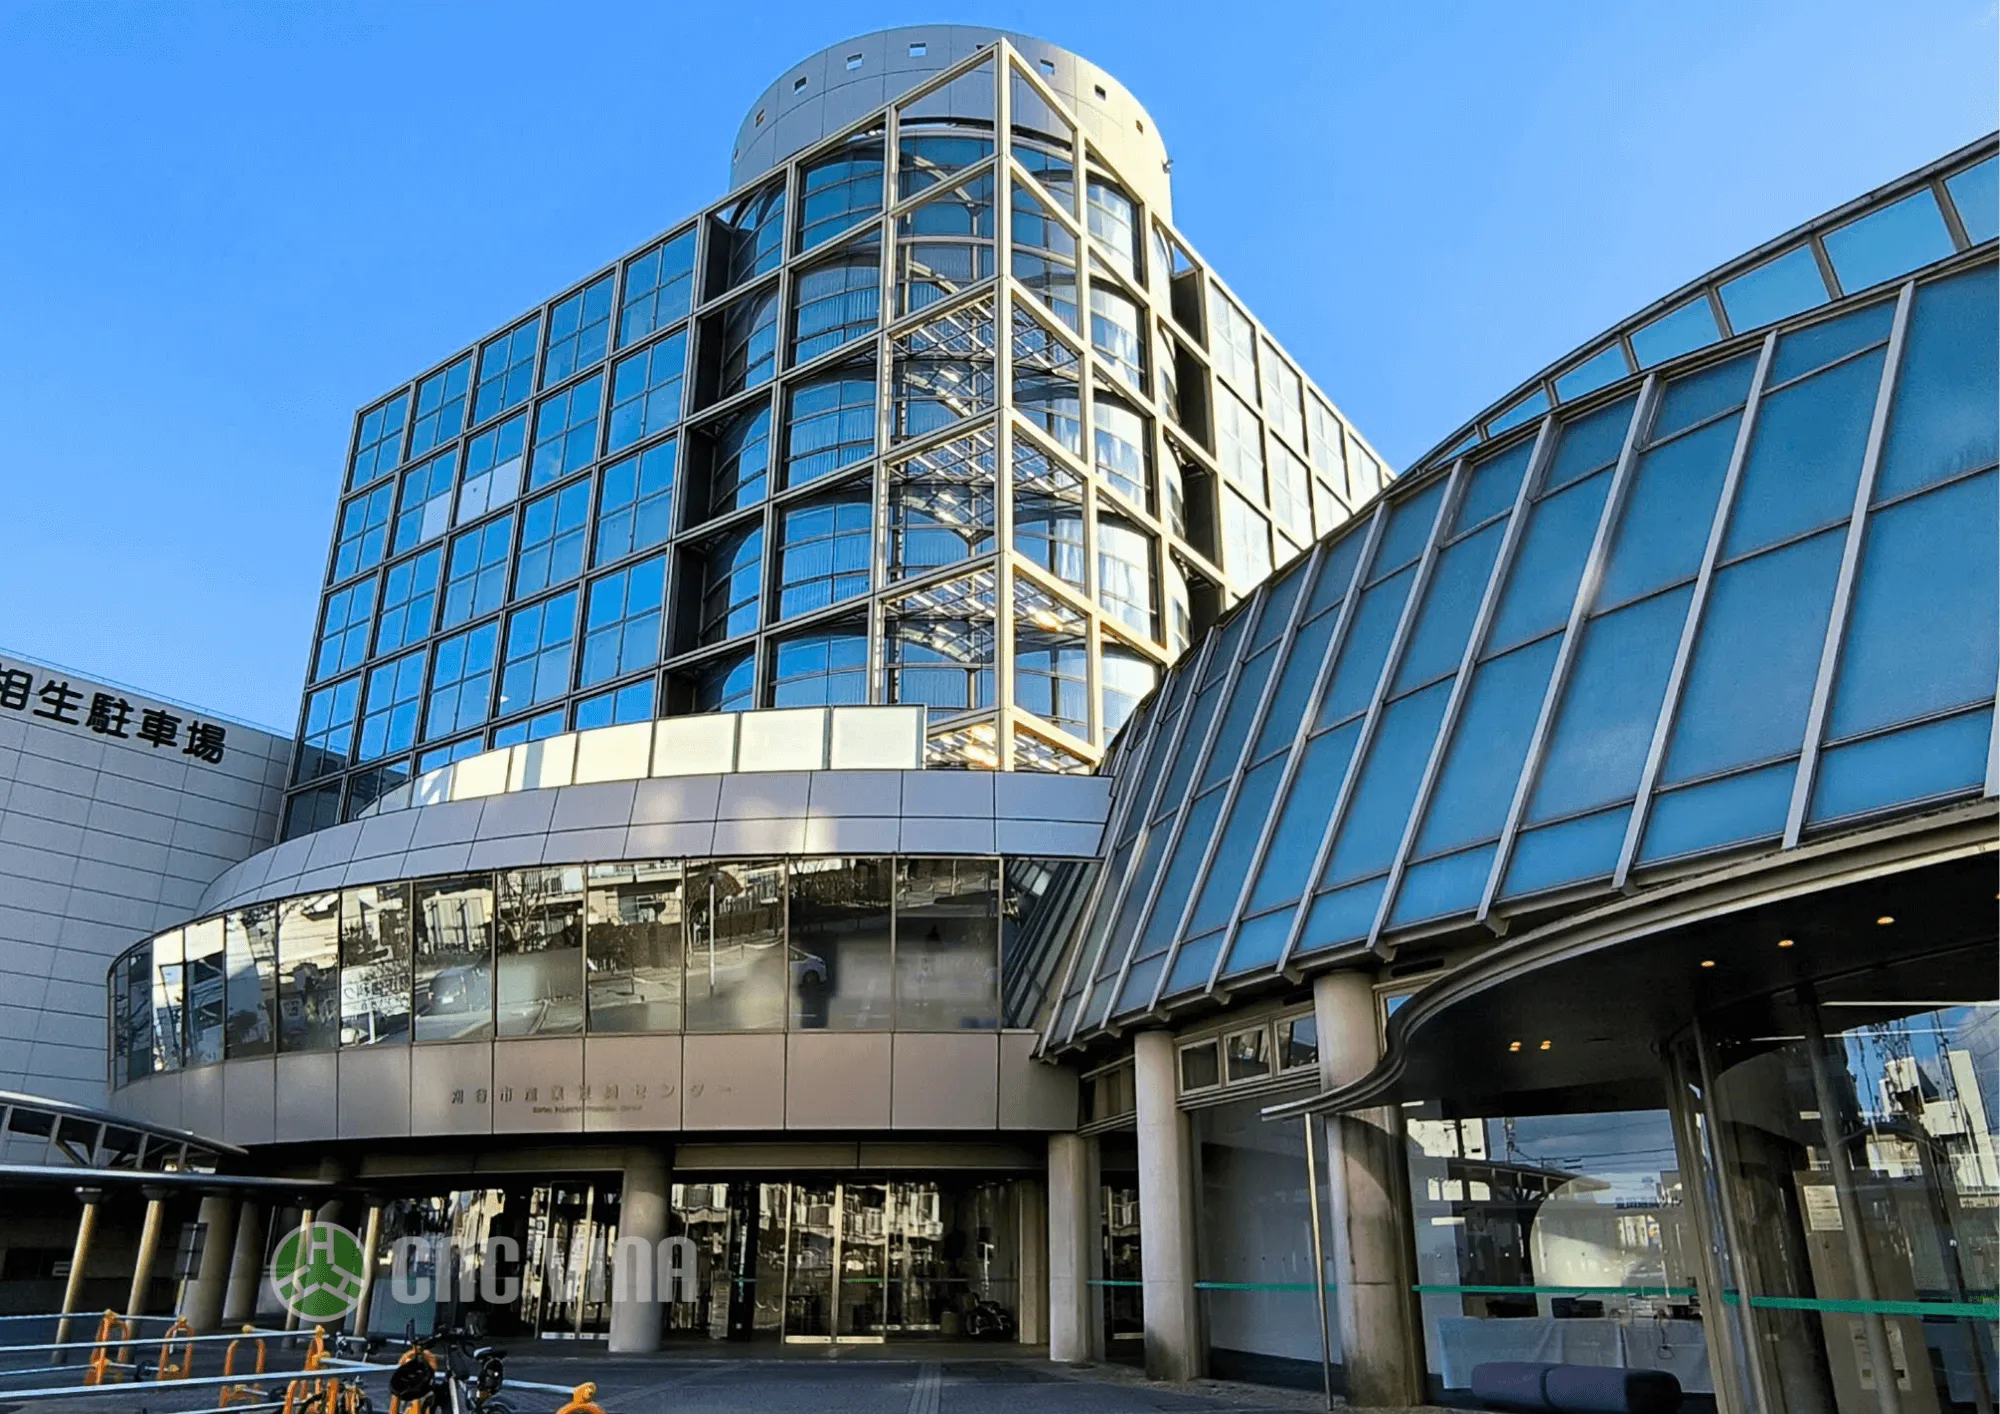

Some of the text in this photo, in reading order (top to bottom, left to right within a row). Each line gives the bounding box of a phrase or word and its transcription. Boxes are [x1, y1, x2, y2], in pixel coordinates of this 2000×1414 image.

[0, 663, 226, 764] 相生駐車場
